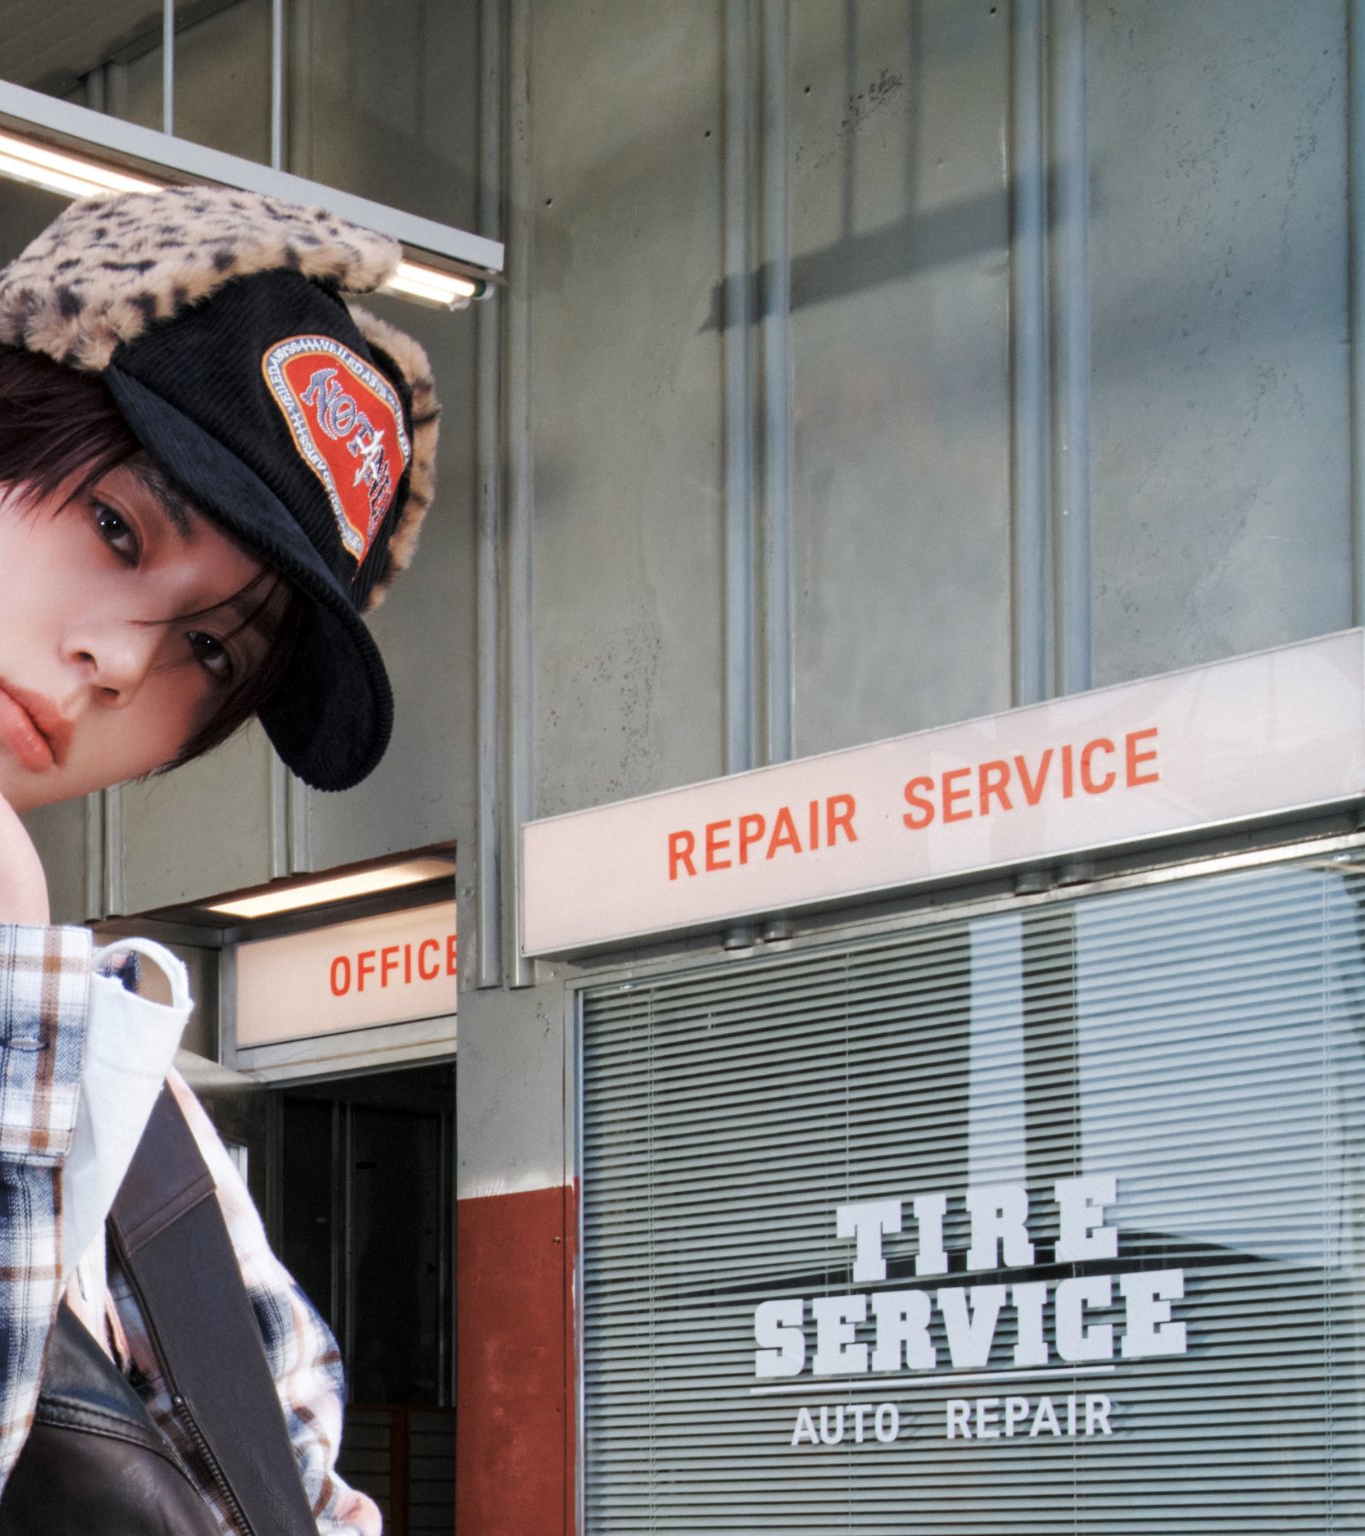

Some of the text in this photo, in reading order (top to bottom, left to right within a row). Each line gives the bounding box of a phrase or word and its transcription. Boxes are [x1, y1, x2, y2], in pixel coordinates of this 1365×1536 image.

[669, 727, 1161, 881] REPAIR SERVICE
[330, 934, 457, 996] OFFICE
[836, 1175, 1119, 1283] TIRE
[754, 1268, 1188, 1379] SERVICE
[791, 1394, 1113, 1446] AUTO REPAIR
